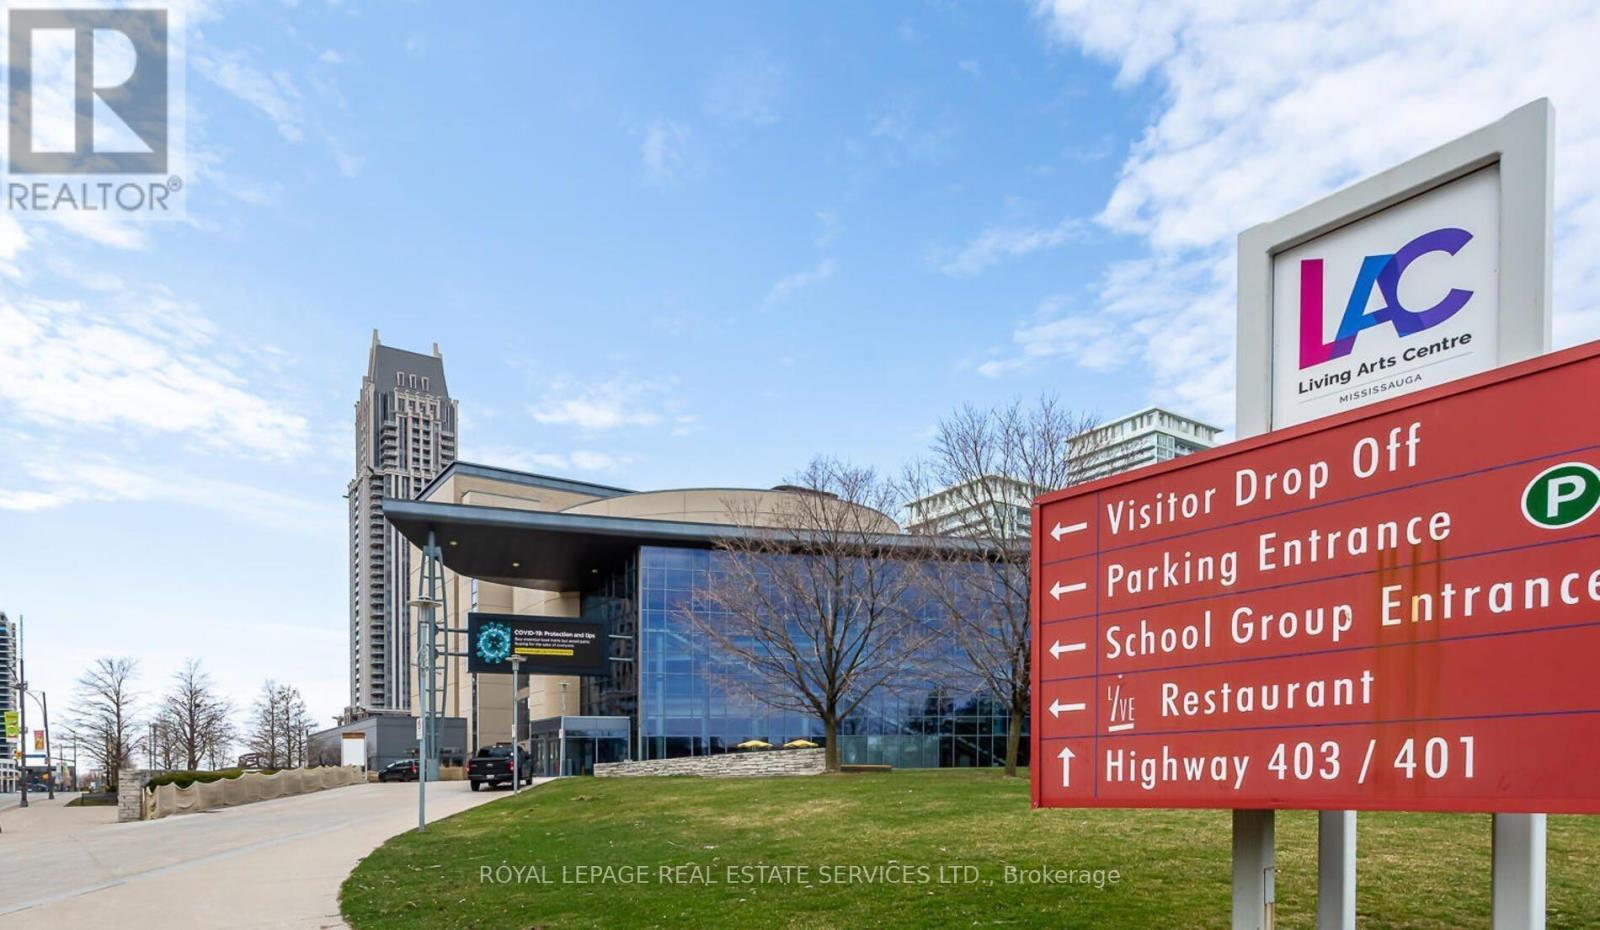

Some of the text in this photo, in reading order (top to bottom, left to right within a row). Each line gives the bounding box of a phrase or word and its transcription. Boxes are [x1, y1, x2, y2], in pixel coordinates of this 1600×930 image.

[1299, 227, 1474, 370] LAC
[1298, 333, 1472, 394] Living Arts Centre
[1339, 373, 1423, 404] MISSISSAUGA
[1106, 421, 1422, 536] Visitor Drop Off
[1547, 474, 1587, 518] P
[1107, 511, 1451, 598] Parking Entrance
[1106, 568, 1600, 660] School Group Entrance
[1161, 670, 1375, 717] Restaurant
[1106, 745, 1250, 790] Highway
[1268, 740, 1341, 781] 403
[1393, 735, 1475, 779] 401
